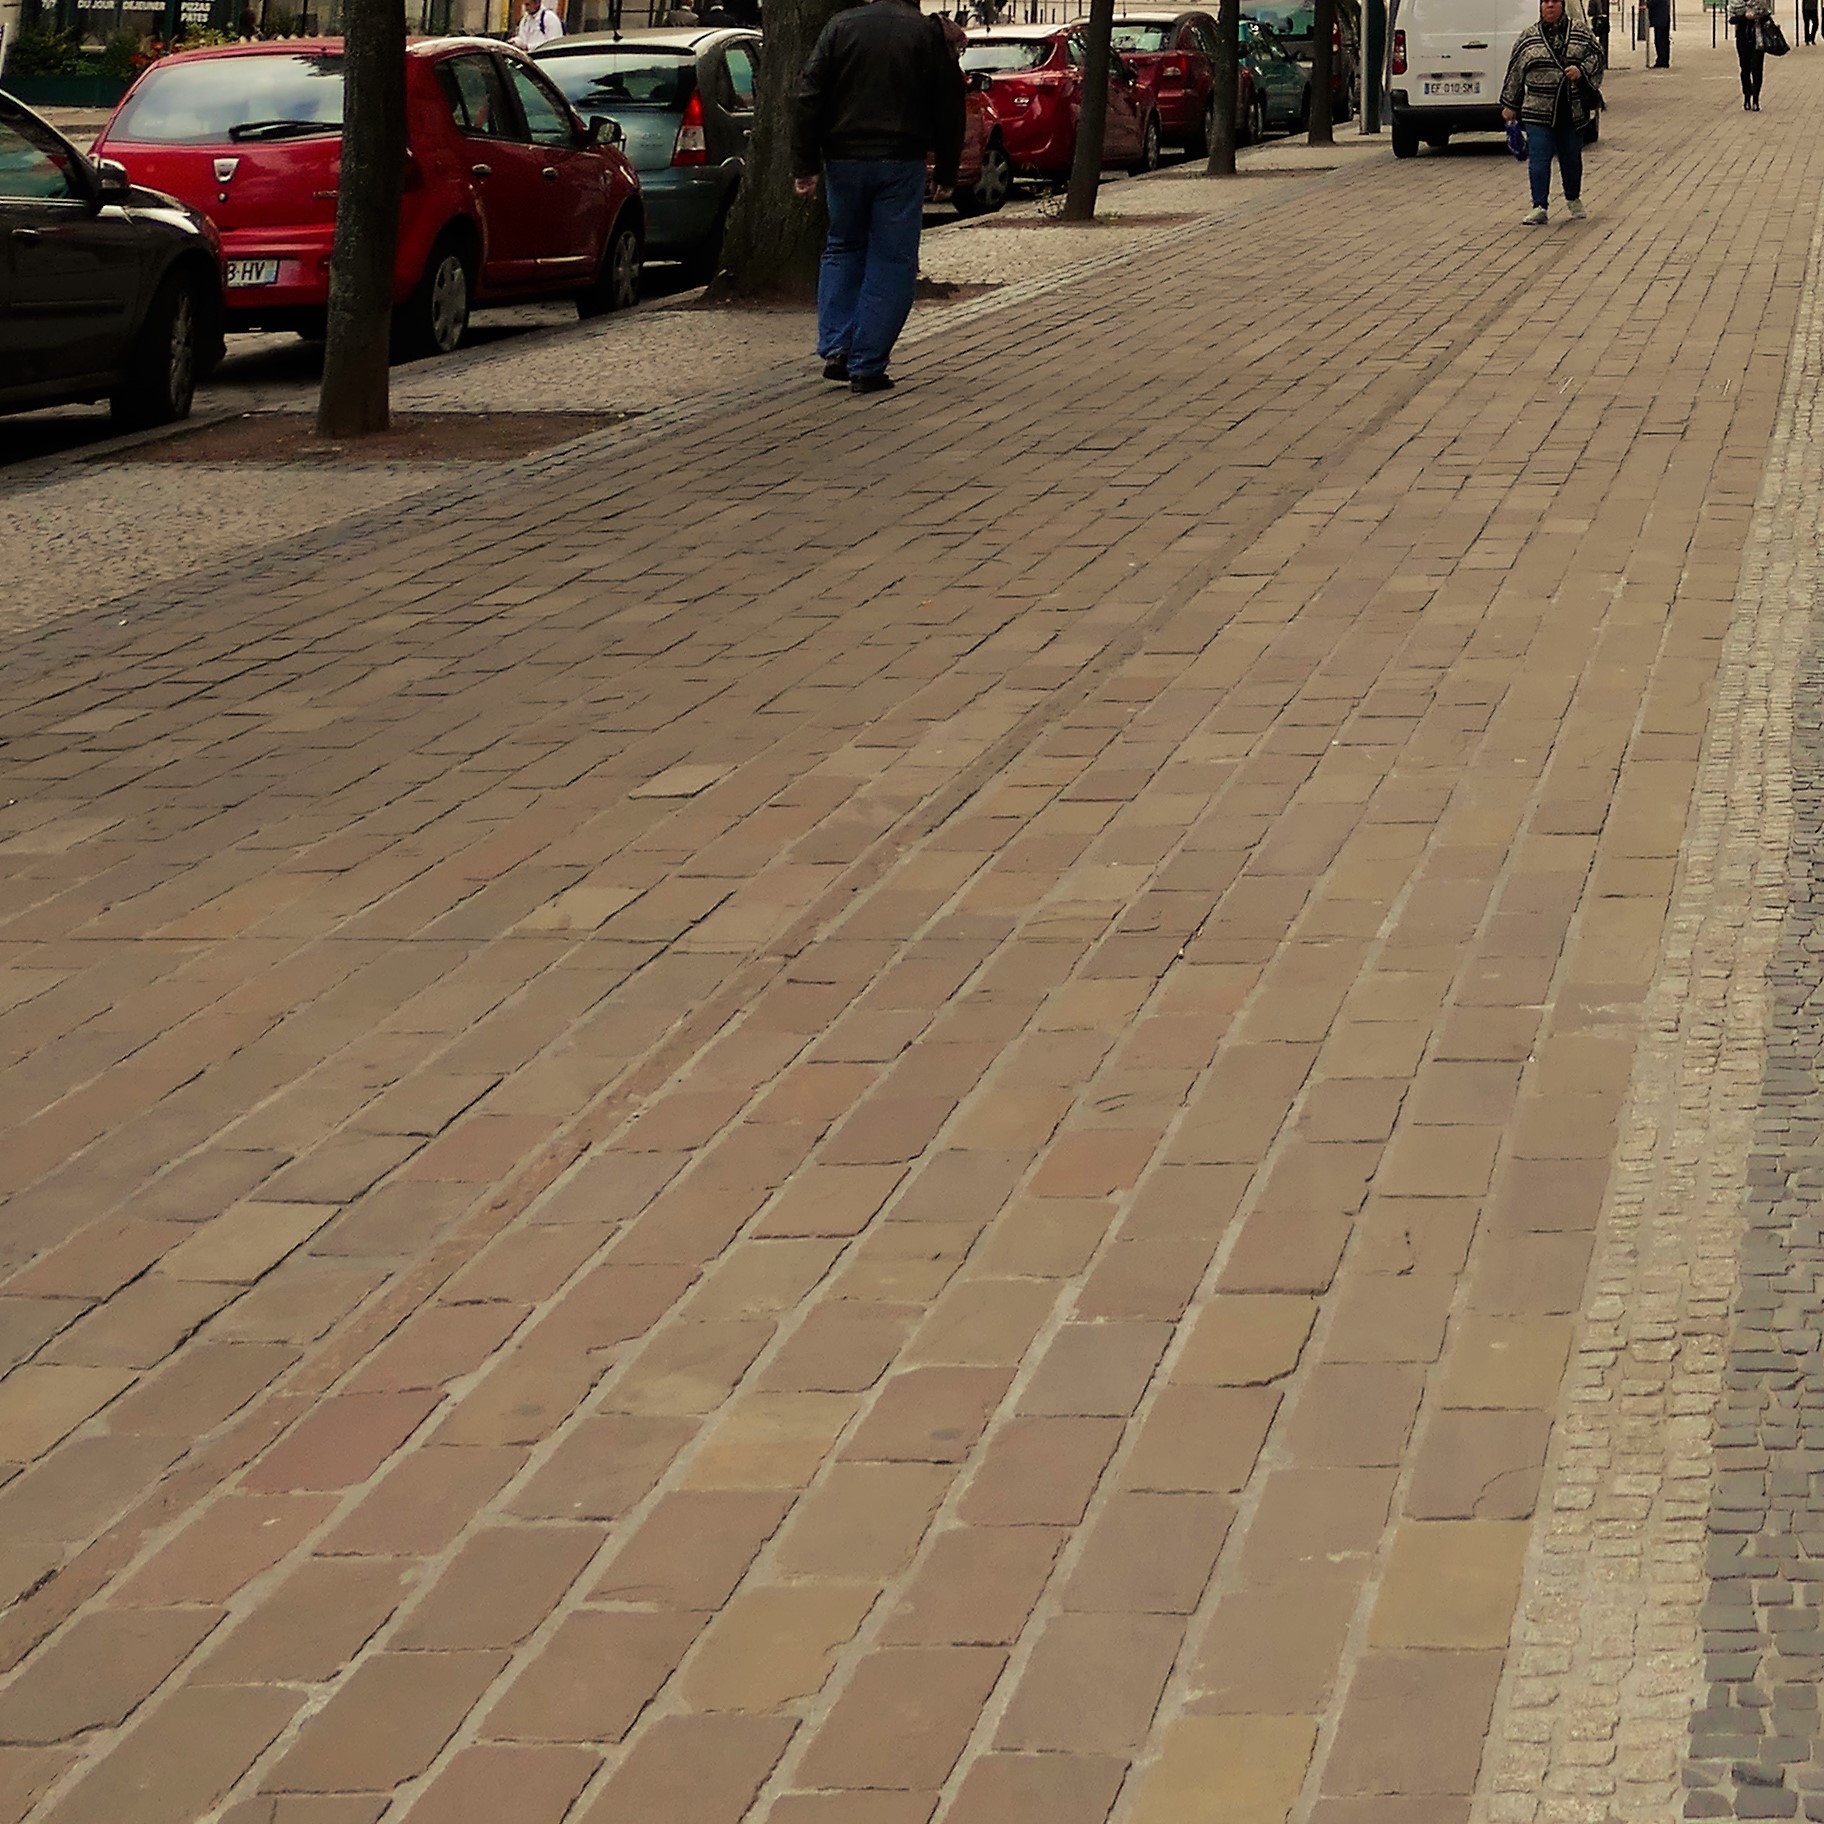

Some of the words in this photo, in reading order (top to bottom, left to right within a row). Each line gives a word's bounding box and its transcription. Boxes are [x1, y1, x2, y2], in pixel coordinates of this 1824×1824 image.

[77, 0, 91, 8] DU
[92, 0, 115, 9] JOUR
[181, 2, 210, 12] PIZZAS
